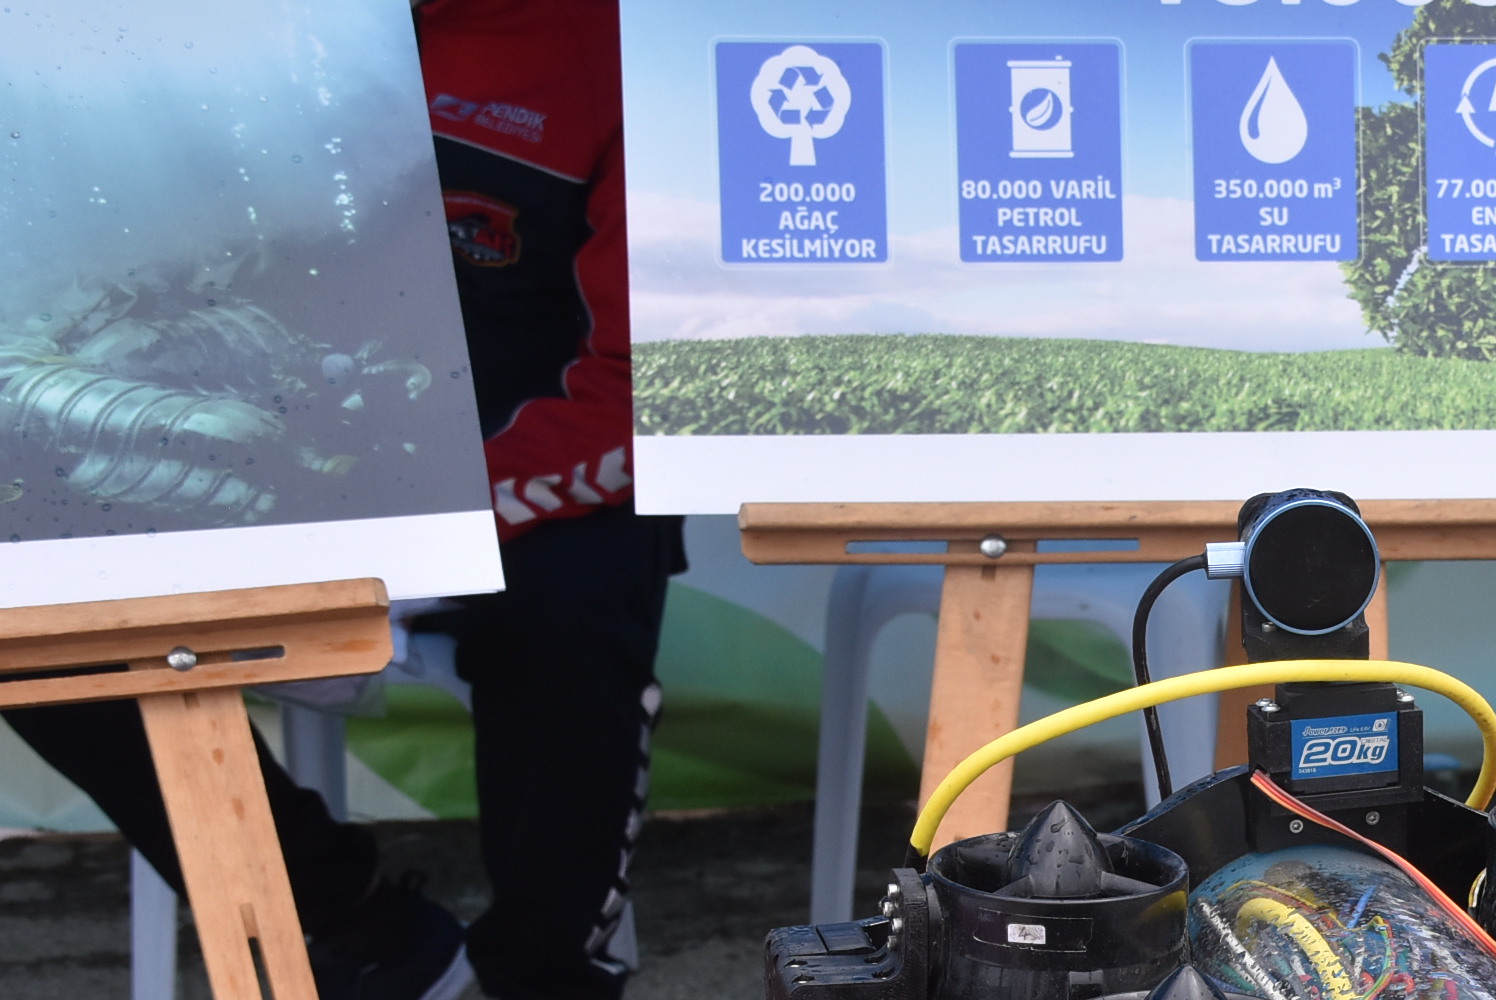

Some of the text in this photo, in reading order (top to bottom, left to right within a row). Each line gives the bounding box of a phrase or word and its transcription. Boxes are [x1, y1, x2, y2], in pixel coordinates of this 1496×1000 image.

[759, 183, 856, 202] 200.000
[961, 175, 1116, 199] 80.000 VARİL
[1214, 179, 1308, 198] 350.000
[778, 206, 839, 234] AĞAÇ
[997, 207, 1082, 227] PETROL
[1259, 207, 1288, 226] SU
[741, 234, 877, 258] KESİLMİYOR
[972, 235, 1107, 255] TASARRUFU
[1207, 234, 1341, 254] TASARRUFU
[1299, 736, 1389, 767] 20kg
